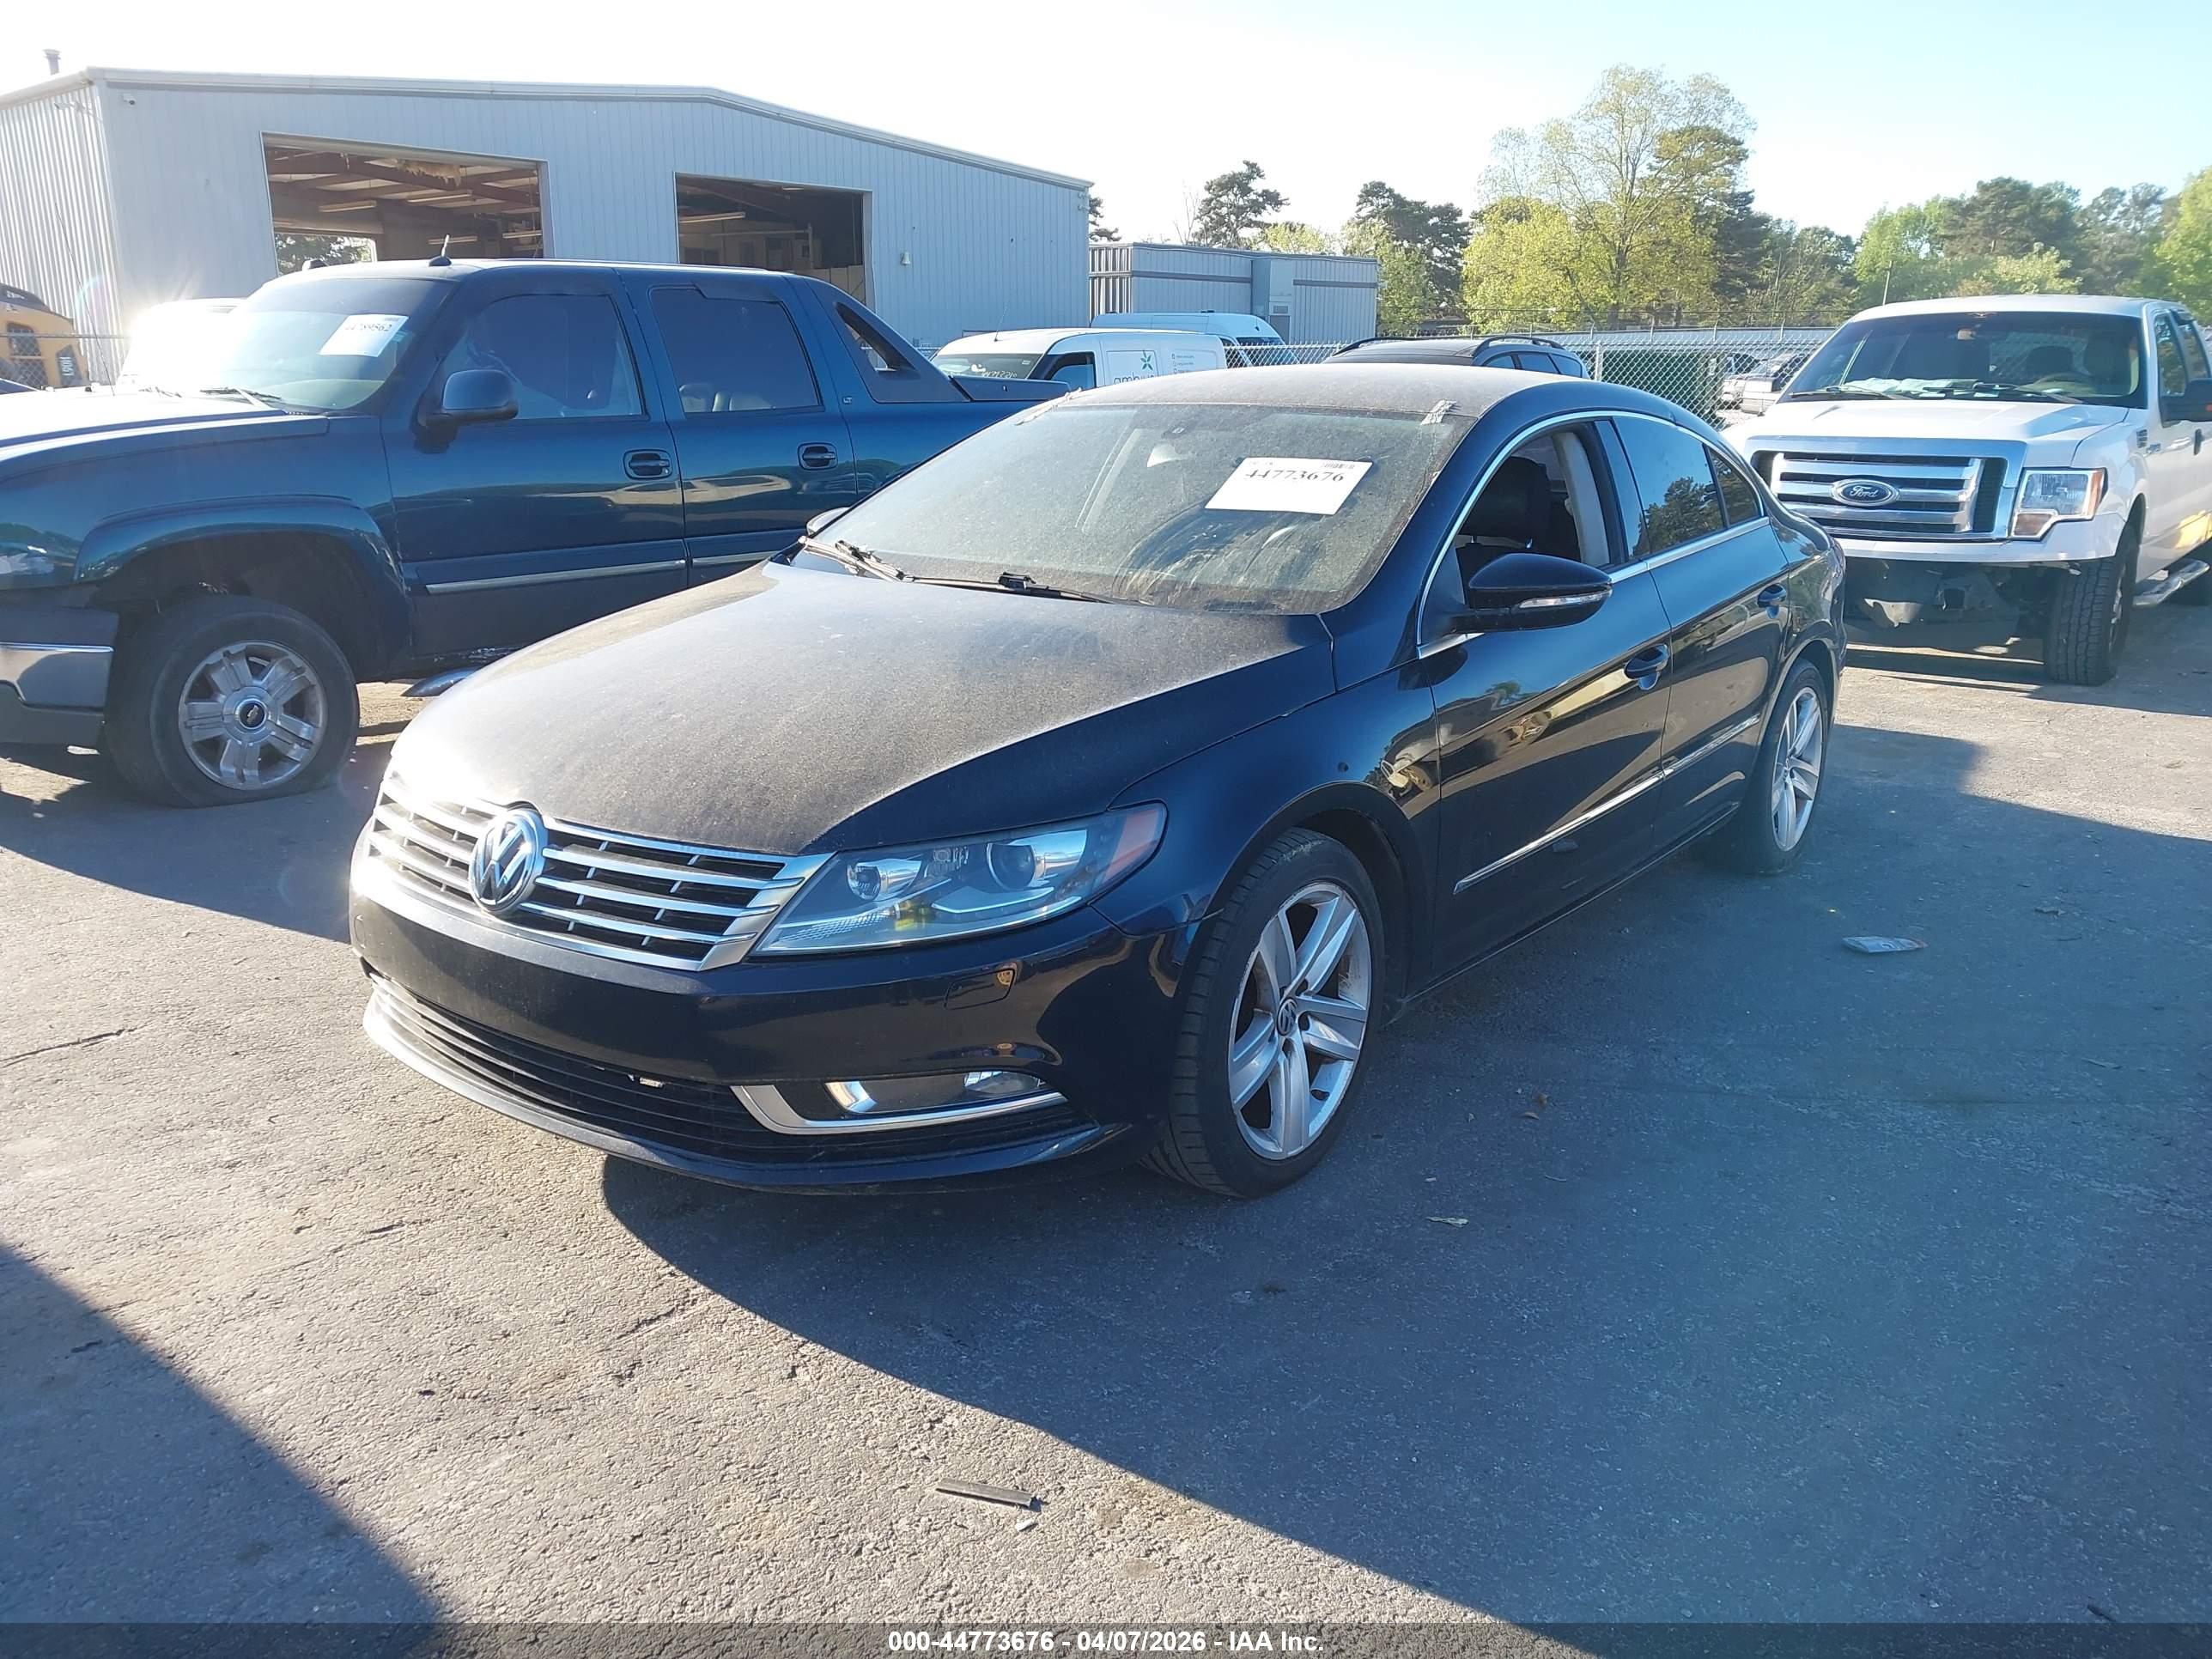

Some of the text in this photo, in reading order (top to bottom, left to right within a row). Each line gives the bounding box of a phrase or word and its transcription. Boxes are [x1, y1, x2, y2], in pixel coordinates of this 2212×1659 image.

[1113, 371, 1155, 385] amb
[1244, 469, 1345, 482] 44773676
[1849, 485, 1879, 498] Ford
